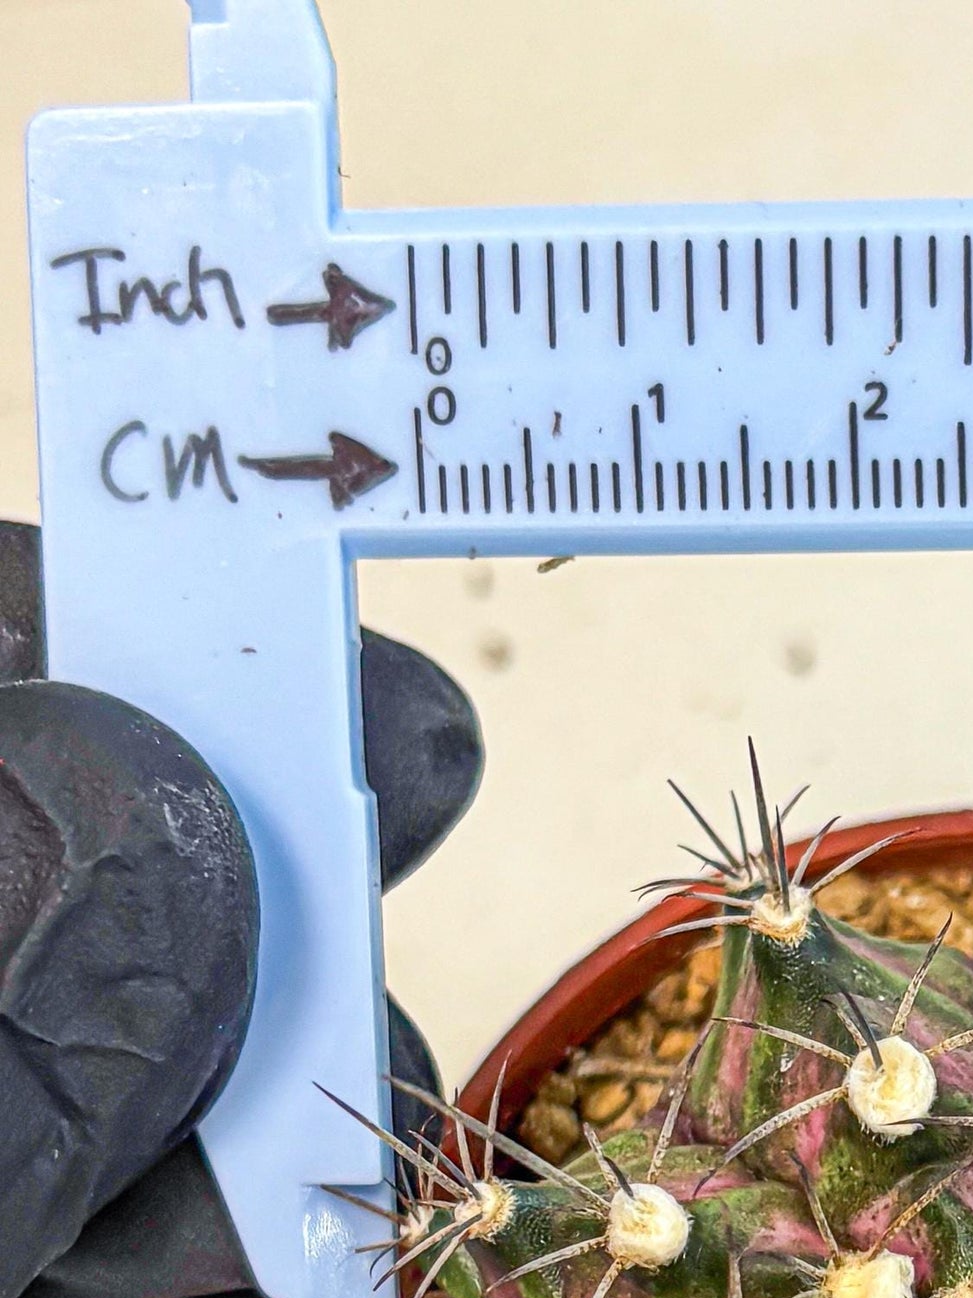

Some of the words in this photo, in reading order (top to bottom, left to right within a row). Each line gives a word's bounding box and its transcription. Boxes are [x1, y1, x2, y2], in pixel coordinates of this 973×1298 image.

[51, 245, 246, 335] Inch
[425, 336, 453, 376] 0
[427, 386, 457, 426] 0
[647, 382, 666, 424] 1
[863, 380, 889, 421] 2
